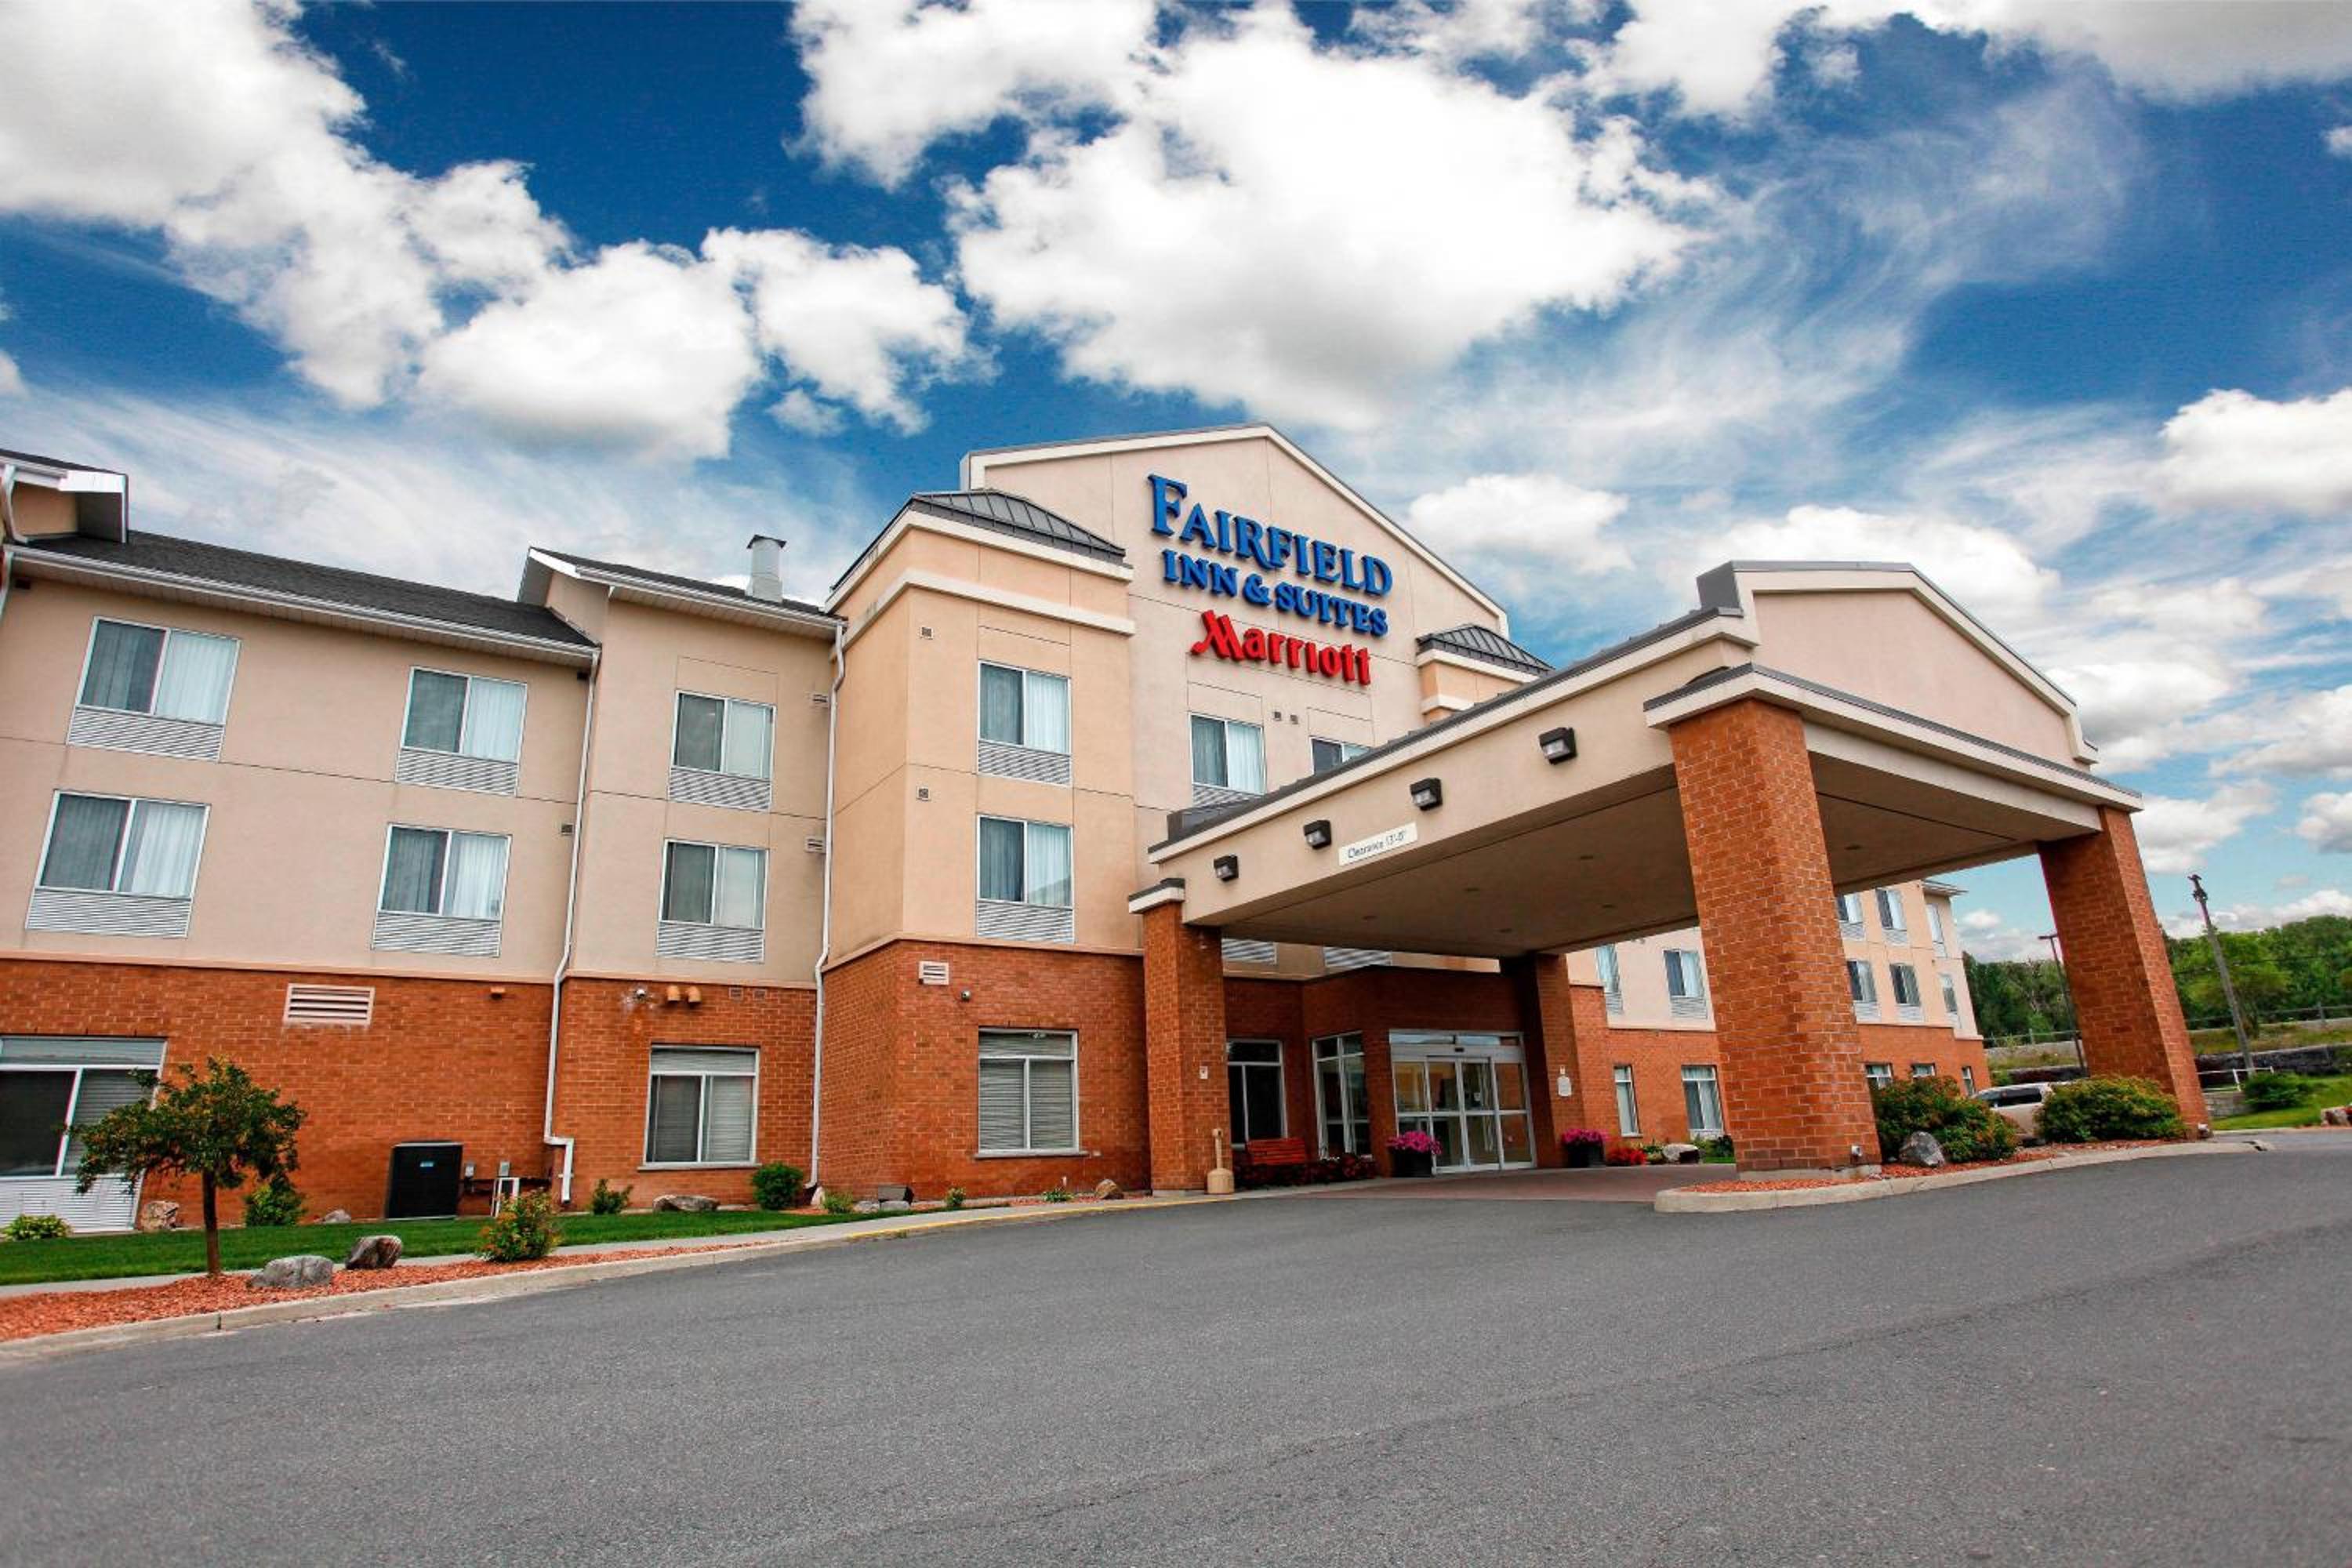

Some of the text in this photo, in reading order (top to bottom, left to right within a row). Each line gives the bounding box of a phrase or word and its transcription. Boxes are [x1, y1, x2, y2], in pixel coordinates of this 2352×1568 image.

[1148, 474, 1394, 597] FAIRFIELD
[1162, 550, 1239, 597] INN
[1274, 580, 1389, 637] SUITES
[1189, 609, 1372, 685] Marriott
